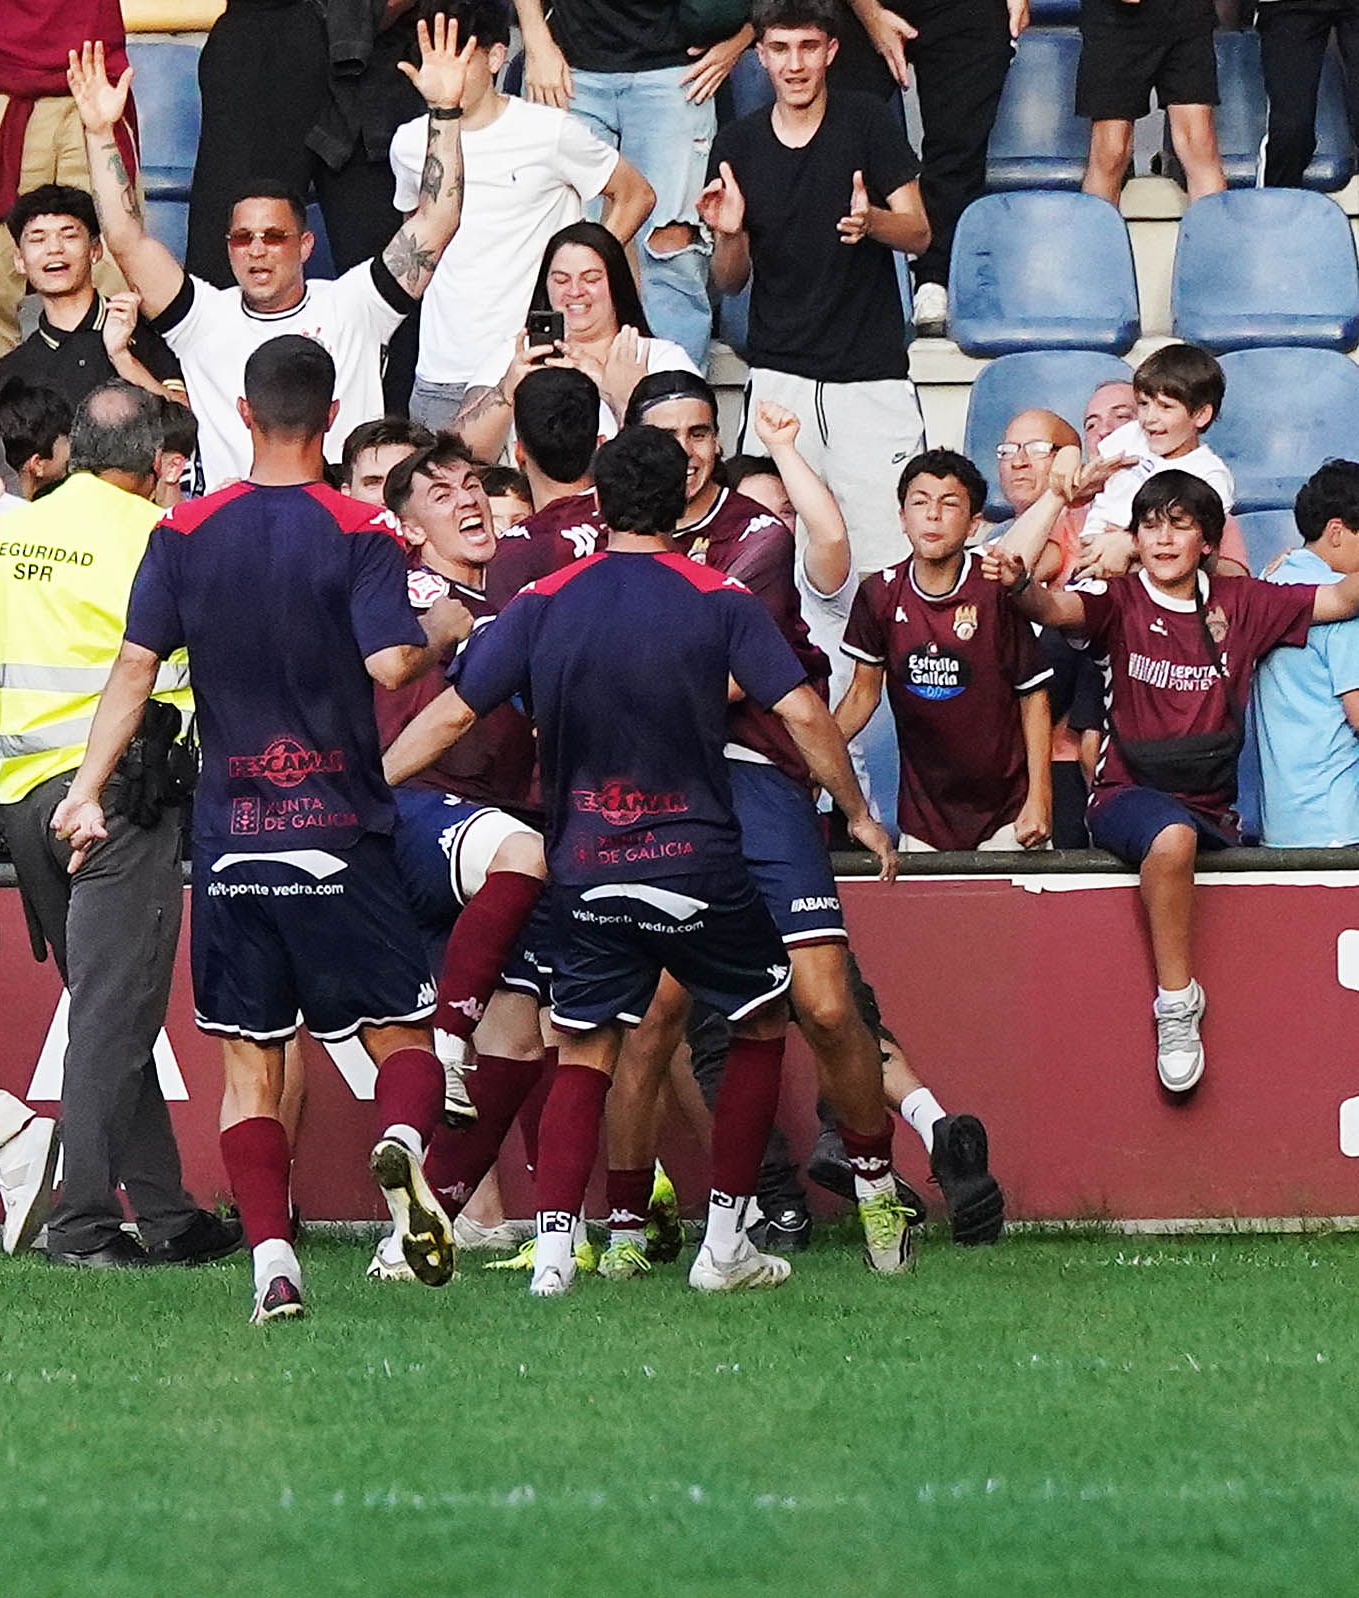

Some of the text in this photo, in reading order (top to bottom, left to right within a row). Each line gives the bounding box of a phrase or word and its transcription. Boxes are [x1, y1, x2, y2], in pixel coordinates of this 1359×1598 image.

[13, 562, 53, 582] SPR
[264, 816, 287, 831] DE
[625, 842, 693, 862] GALICIA
[792, 897, 840, 912] ABANC
[542, 1211, 571, 1233] FS
